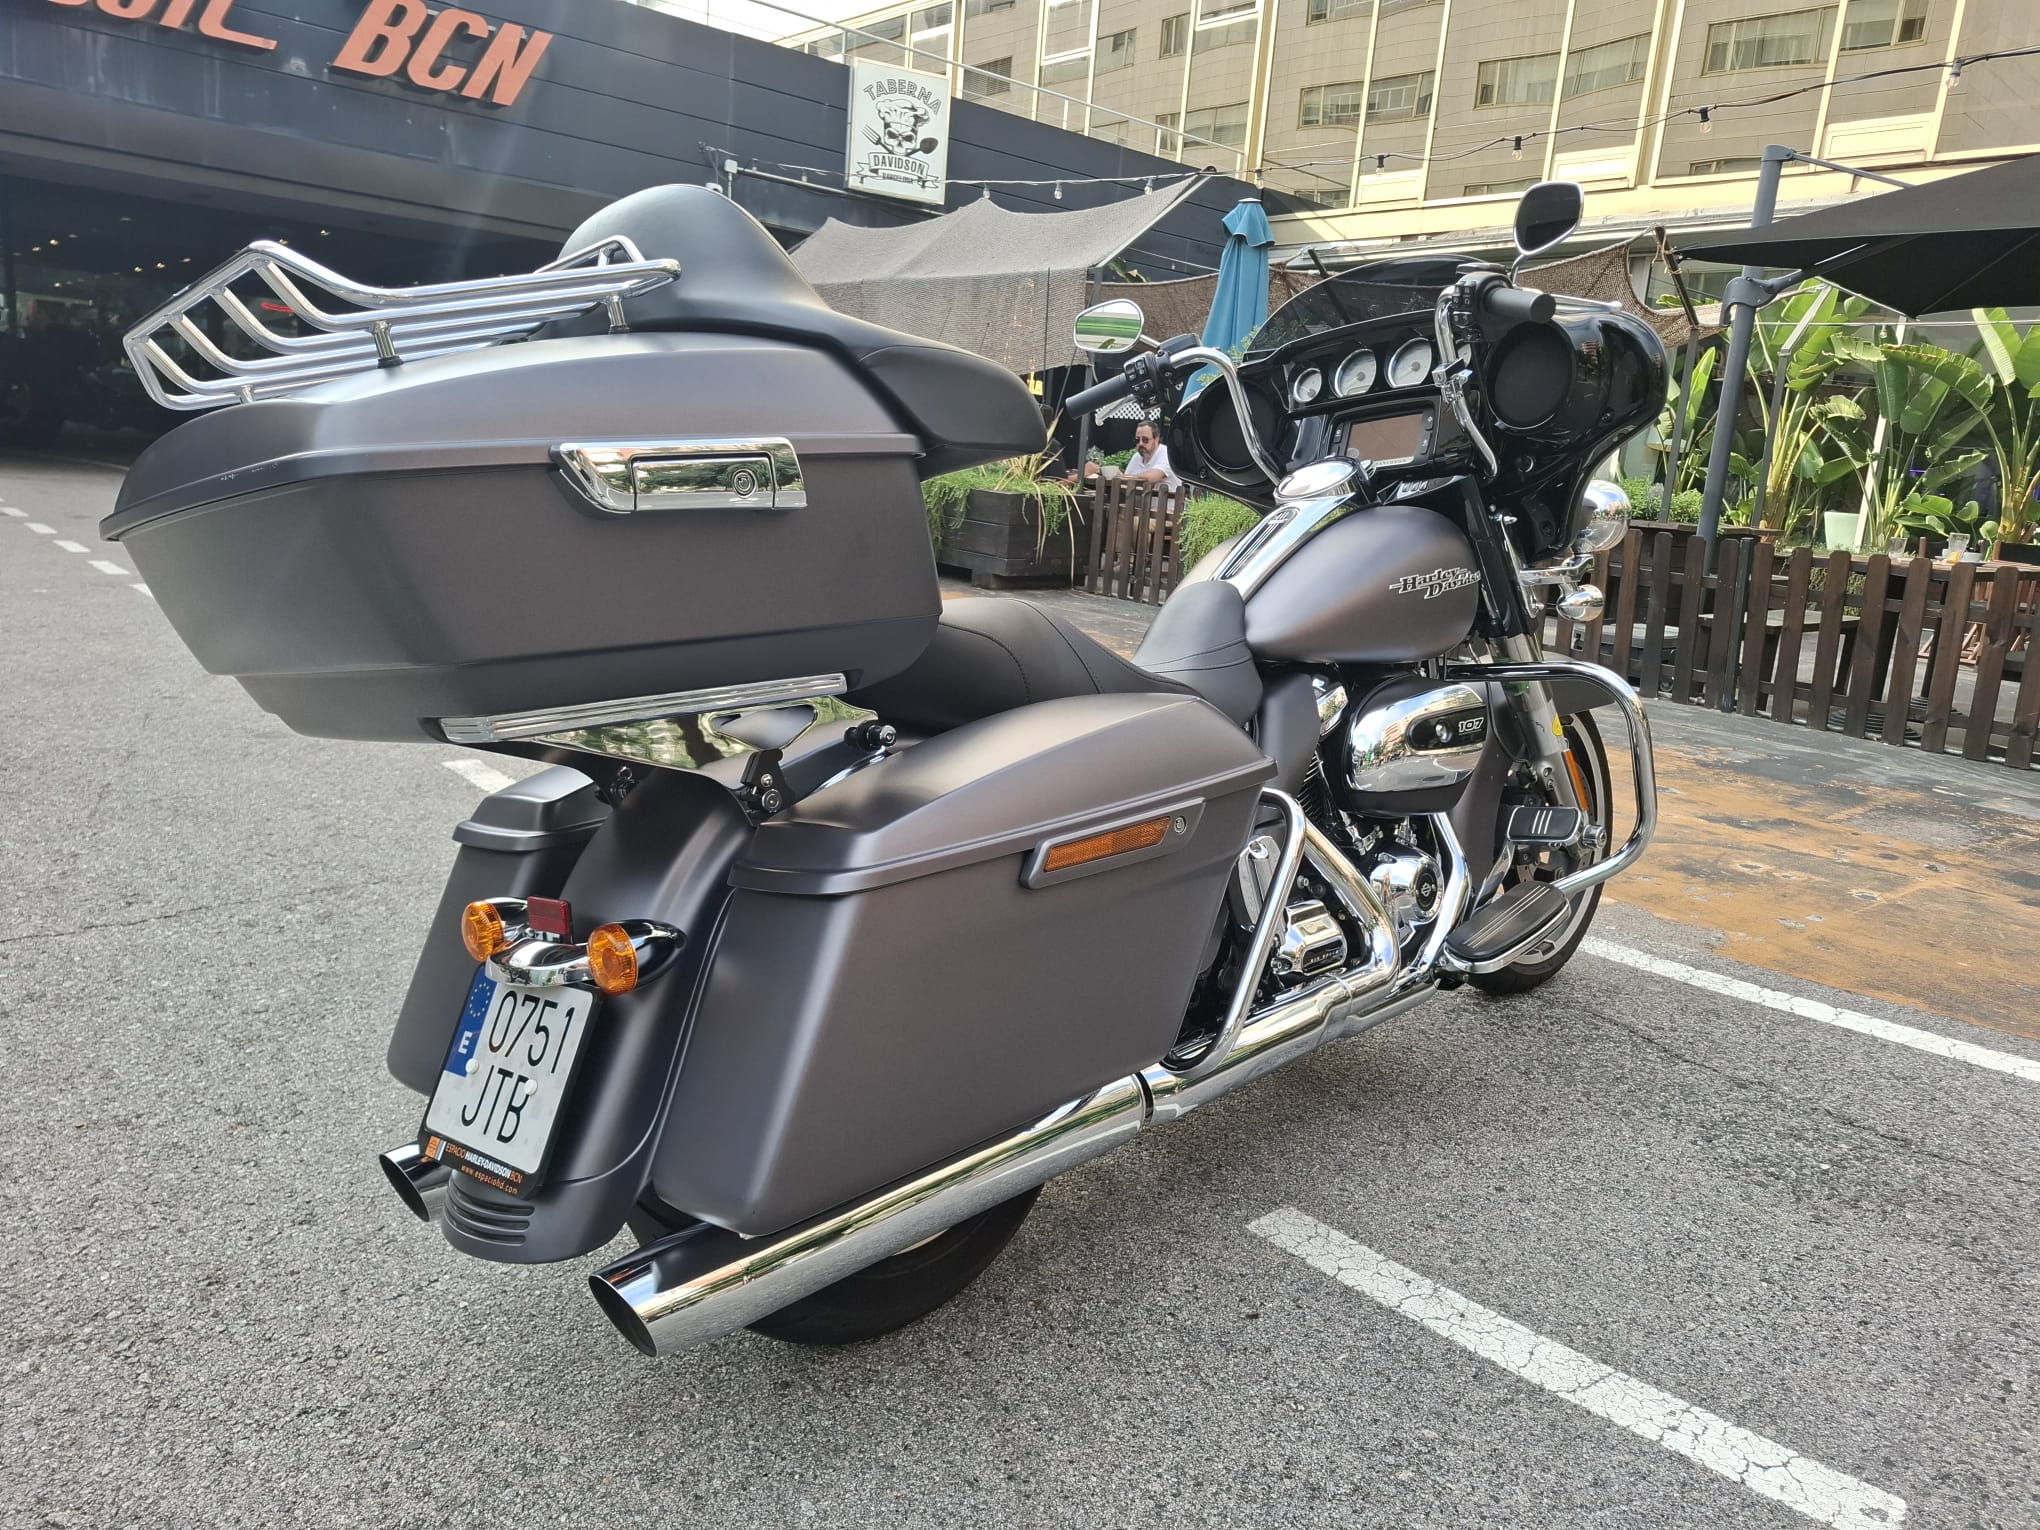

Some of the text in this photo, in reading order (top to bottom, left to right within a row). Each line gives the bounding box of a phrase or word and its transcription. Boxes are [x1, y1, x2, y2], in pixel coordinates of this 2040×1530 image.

[332, 0, 553, 106] BCN
[863, 78, 942, 115] TABERNA
[873, 154, 926, 175] DAVIDSON
[1458, 717, 1484, 733] 107
[457, 1030, 473, 1055] E
[488, 990, 576, 1074] 0751
[461, 1064, 531, 1144] JTB
[461, 1164, 518, 1194] www.espaciohd.com
